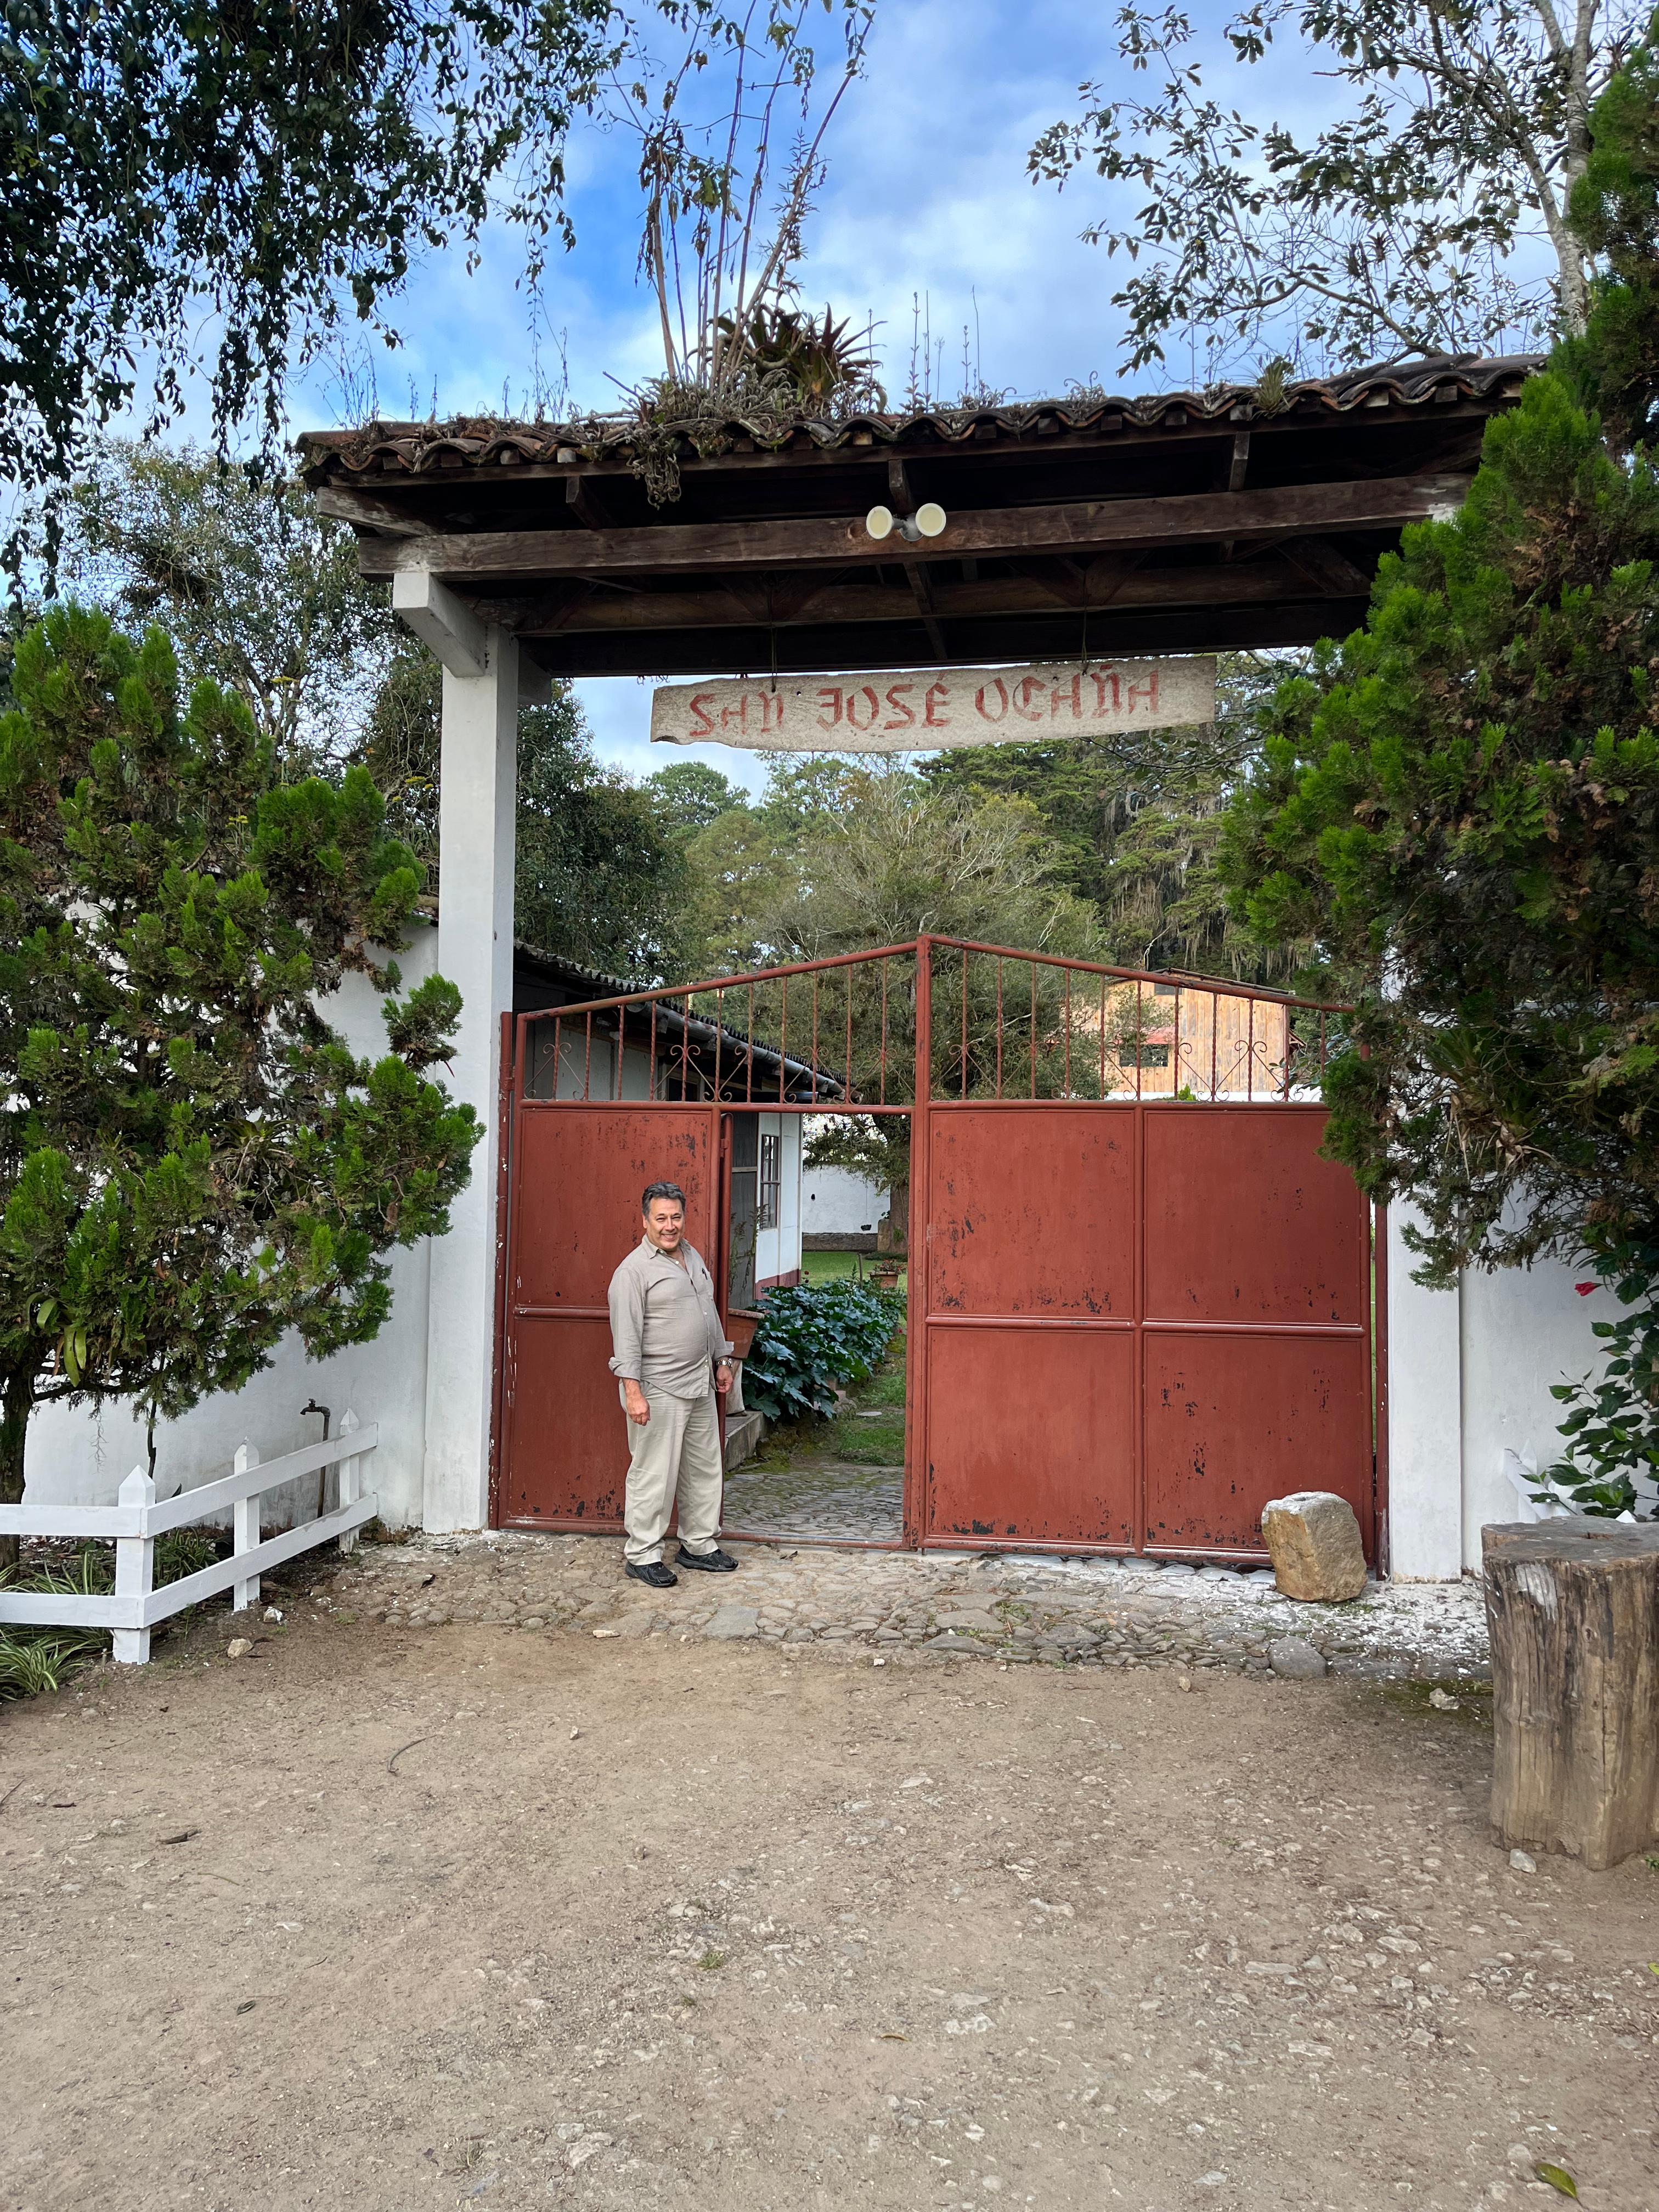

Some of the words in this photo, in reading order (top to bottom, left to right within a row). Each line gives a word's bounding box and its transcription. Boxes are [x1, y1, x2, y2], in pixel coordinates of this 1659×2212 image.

[689, 690, 785, 737] SAN
[815, 673, 952, 732] JOSÉ
[974, 663, 1159, 724] OCAÑA
